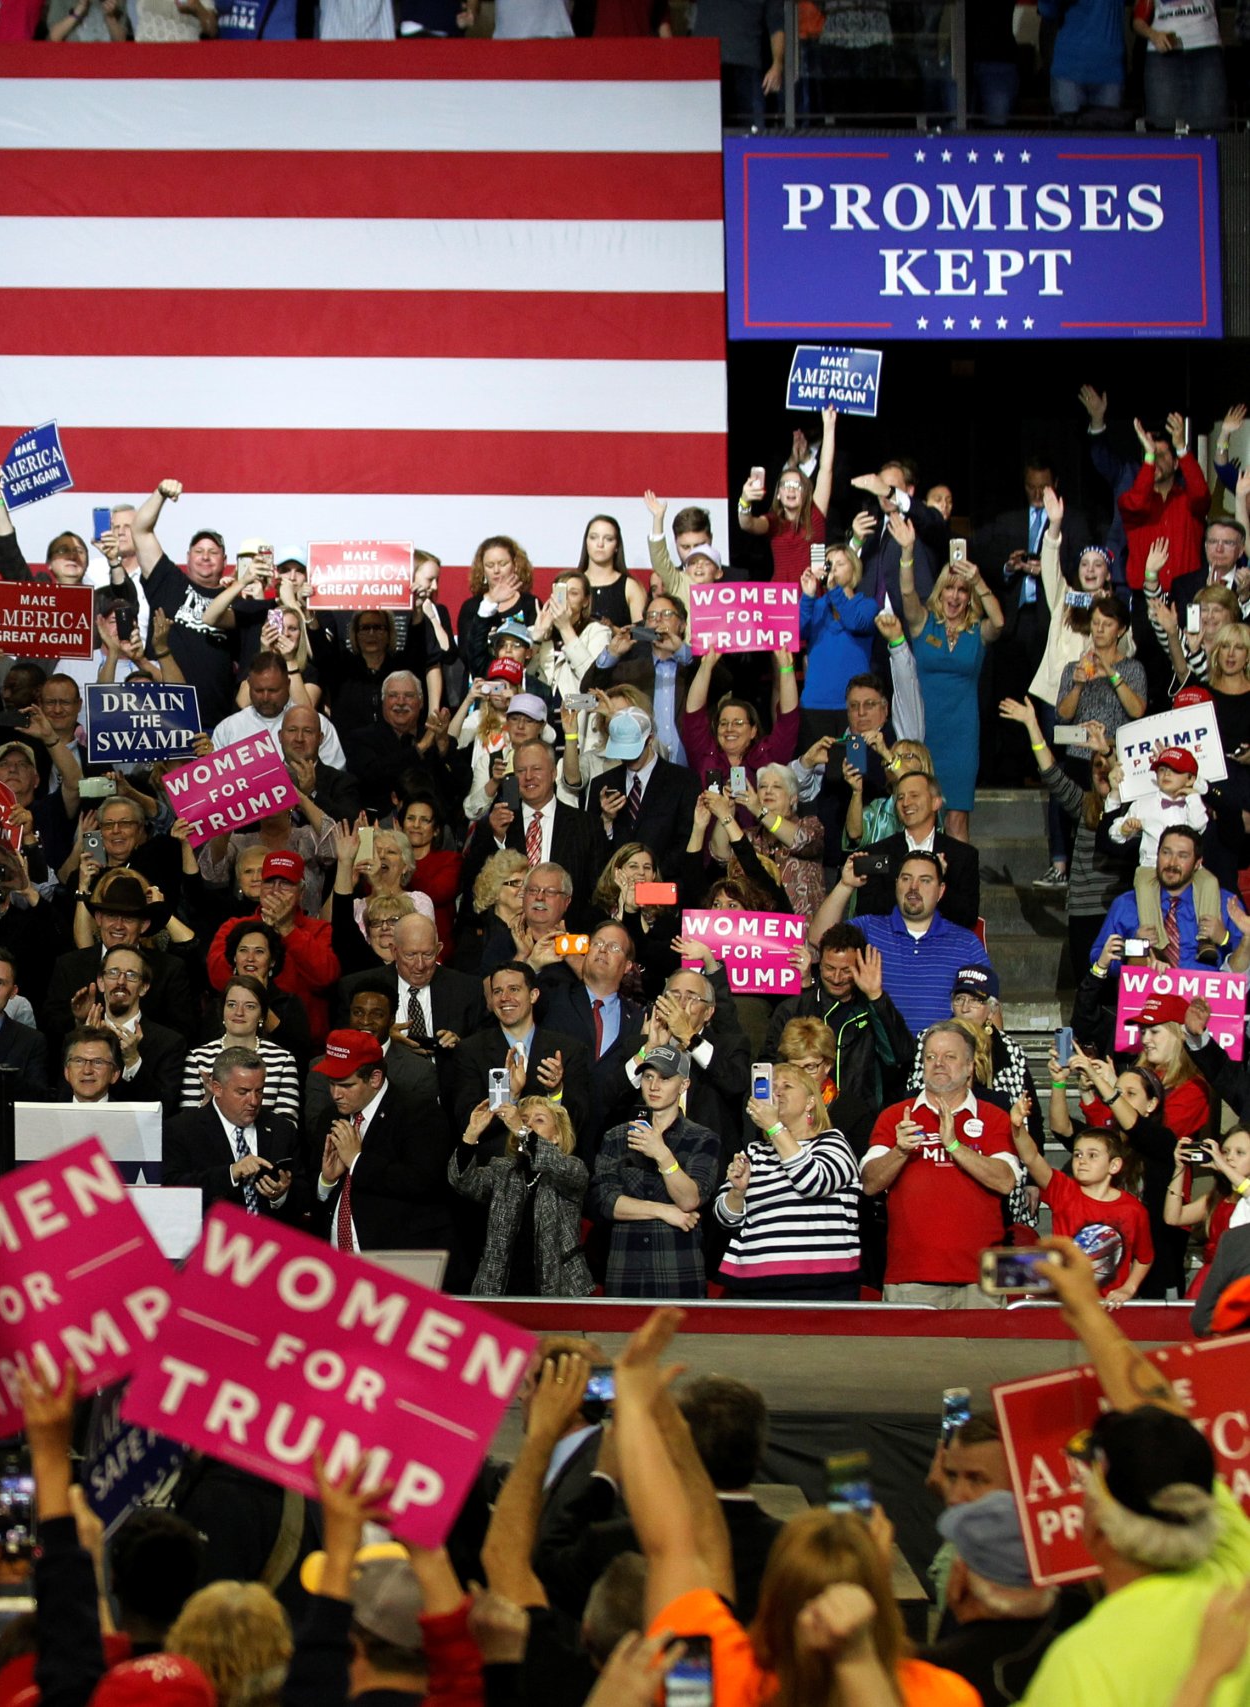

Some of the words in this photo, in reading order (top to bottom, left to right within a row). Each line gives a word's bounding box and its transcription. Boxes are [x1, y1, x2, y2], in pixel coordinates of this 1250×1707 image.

[782, 183, 1165, 232] PROMISES
[879, 249, 1072, 296] KEPT
[820, 356, 849, 368] MAKE
[791, 367, 875, 391] AMERICA
[798, 385, 825, 399] SAFE
[828, 387, 866, 404] AGAIN
[14, 439, 37, 457] MAKE
[0, 446, 62, 485] AMERICA
[10, 478, 33, 496] SAFE
[33, 466, 61, 489] AGAIN
[343, 551, 377, 561] MAKE
[311, 564, 409, 581] AMERICA
[20, 595, 56, 606] MAKE
[317, 584, 359, 595] GREAT
[361, 584, 403, 596] AGAIN
[691, 587, 798, 606] WOMEN
[726, 610, 763, 624] FOR
[39, 633, 83, 645] AGAIN
[697, 629, 793, 649] TRUMP
[101, 693, 185, 713] DRAIN
[130, 714, 161, 728] THE
[97, 729, 195, 751] SWAMP
[166, 736, 275, 796] WOMEN
[1133, 744, 1203, 769] PEE
[209, 778, 249, 803] FOR
[189, 785, 287, 837] TRUMP
[684, 916, 803, 939] WOMEN
[721, 945, 762, 959] FOR
[690, 967, 795, 987] UMP
[958, 969, 987, 982] TRUMP
[1122, 972, 1245, 1000] WOMEN
[204, 1218, 529, 1400] WOMEN
[266, 1334, 387, 1413] FOR
[159, 1356, 447, 1515] TRUMP
[90, 1428, 146, 1502] SAFE
